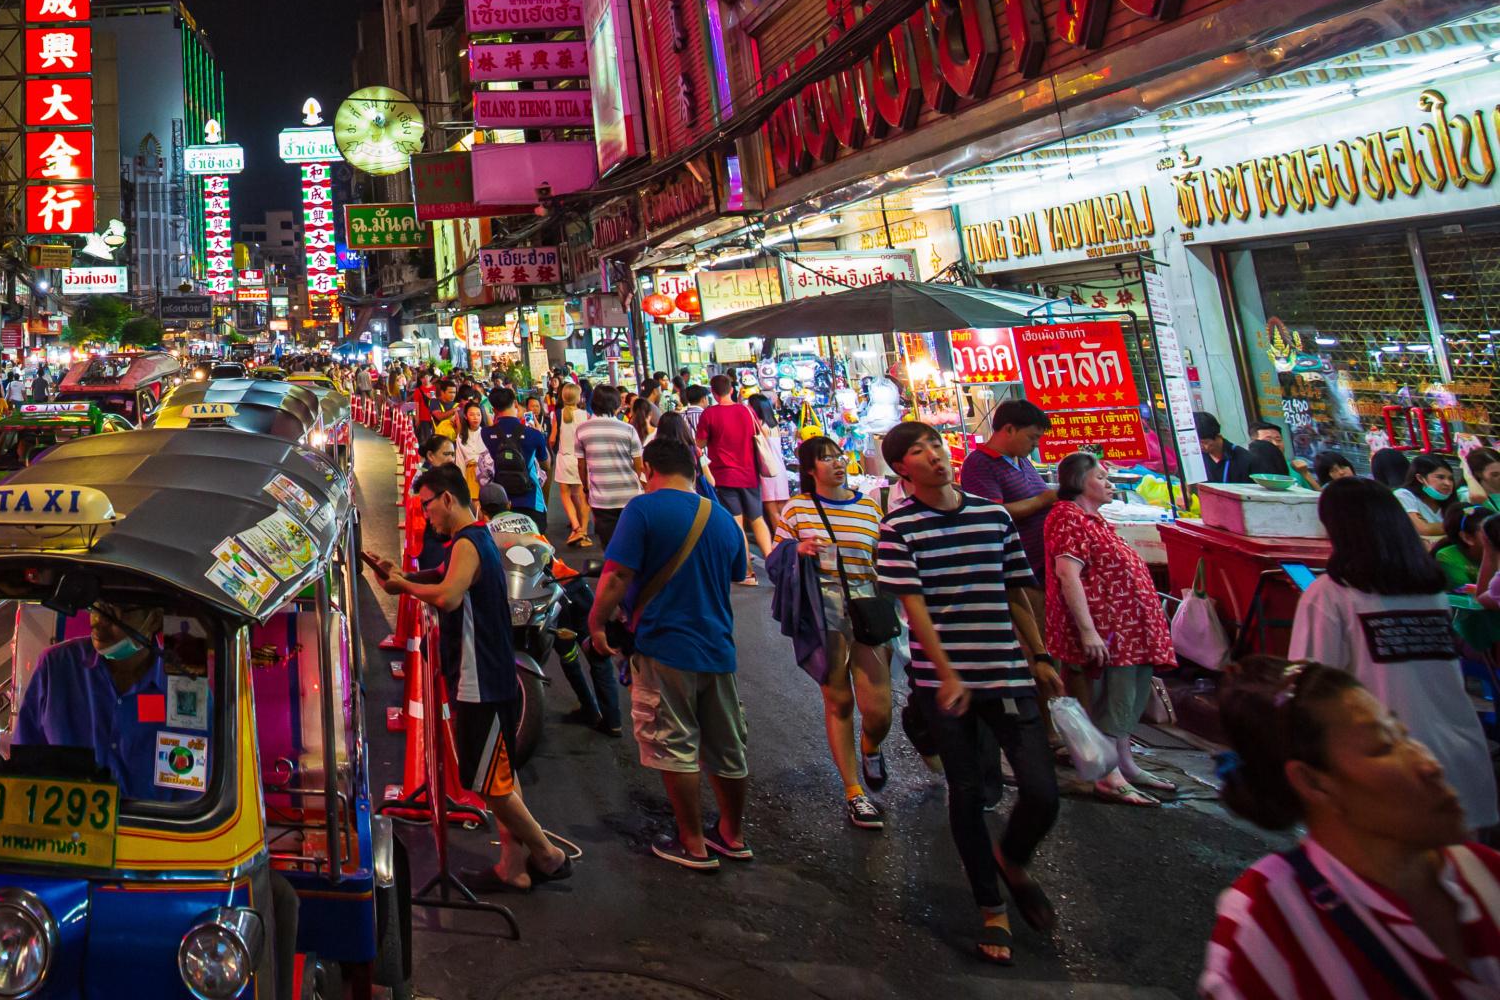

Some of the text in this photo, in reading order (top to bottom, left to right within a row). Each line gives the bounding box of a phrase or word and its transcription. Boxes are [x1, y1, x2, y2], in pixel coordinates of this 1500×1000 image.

[480, 101, 517, 118] SIANG
[519, 100, 551, 117] HENG
[555, 100, 579, 117] HUA
[211, 179, 226, 291] 和成興大金行
[308, 165, 330, 291] 和成興大金行
[963, 219, 1008, 264] TONG
[1008, 211, 1042, 258] BAI
[1043, 184, 1155, 252] YAOWARAJ
[43, 404, 71, 412] TAXI
[192, 404, 225, 414] TAXI
[25, 784, 111, 830] 1293
